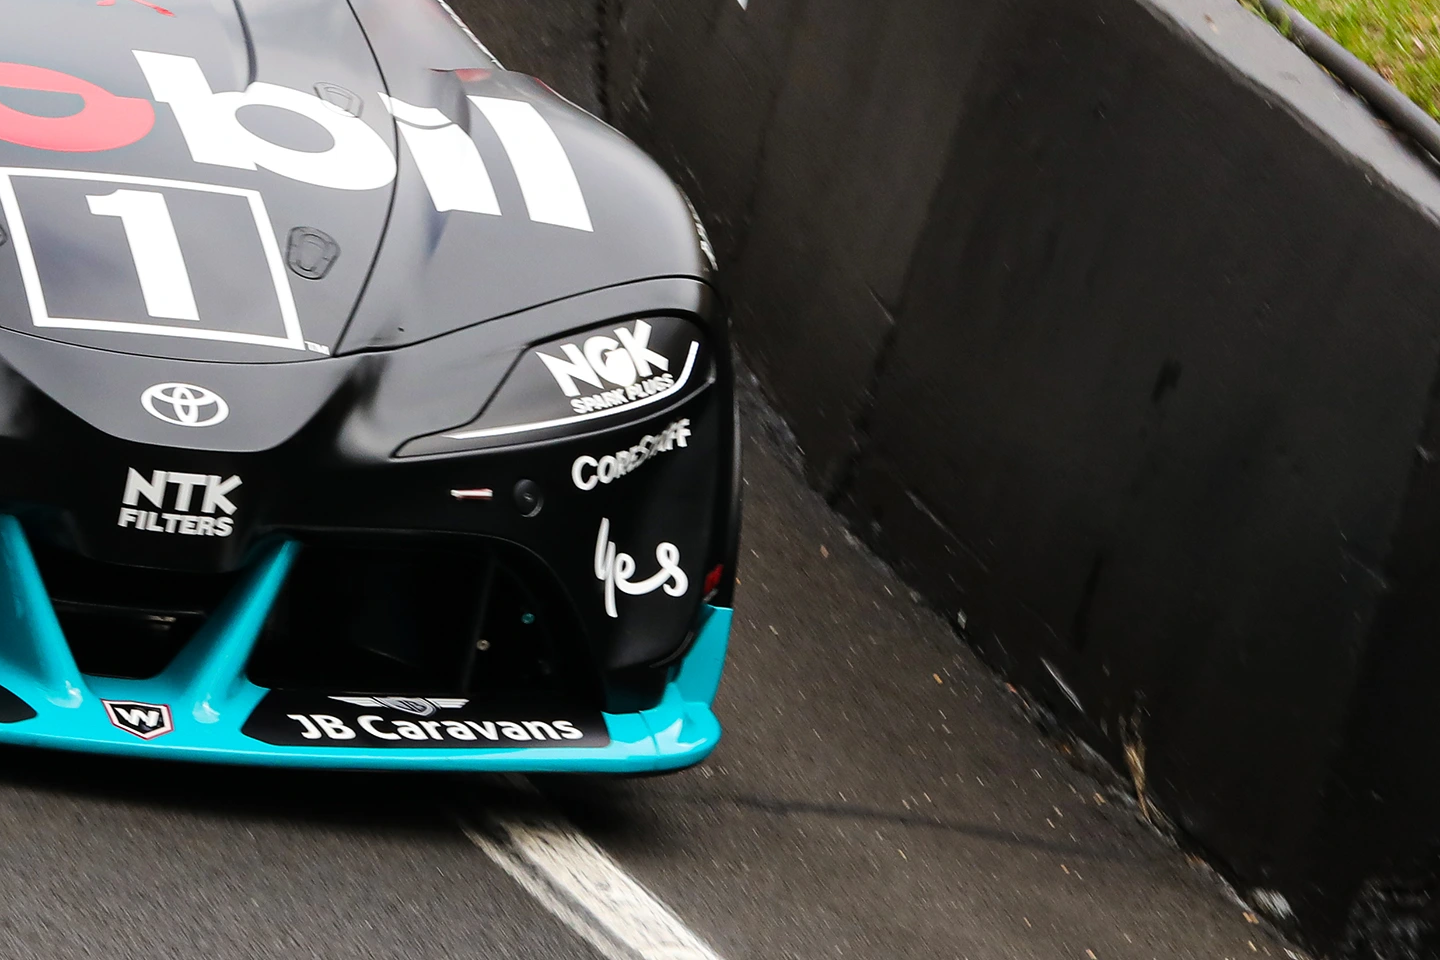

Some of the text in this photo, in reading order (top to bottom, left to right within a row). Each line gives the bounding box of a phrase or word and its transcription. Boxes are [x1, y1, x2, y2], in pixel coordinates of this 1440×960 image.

[85, 189, 200, 321] 1
[535, 319, 669, 397] NGK
[117, 507, 234, 537] FILTERS
[122, 466, 243, 516] NTK
[594, 517, 689, 618] yes
[286, 713, 584, 741] JB Caravans
